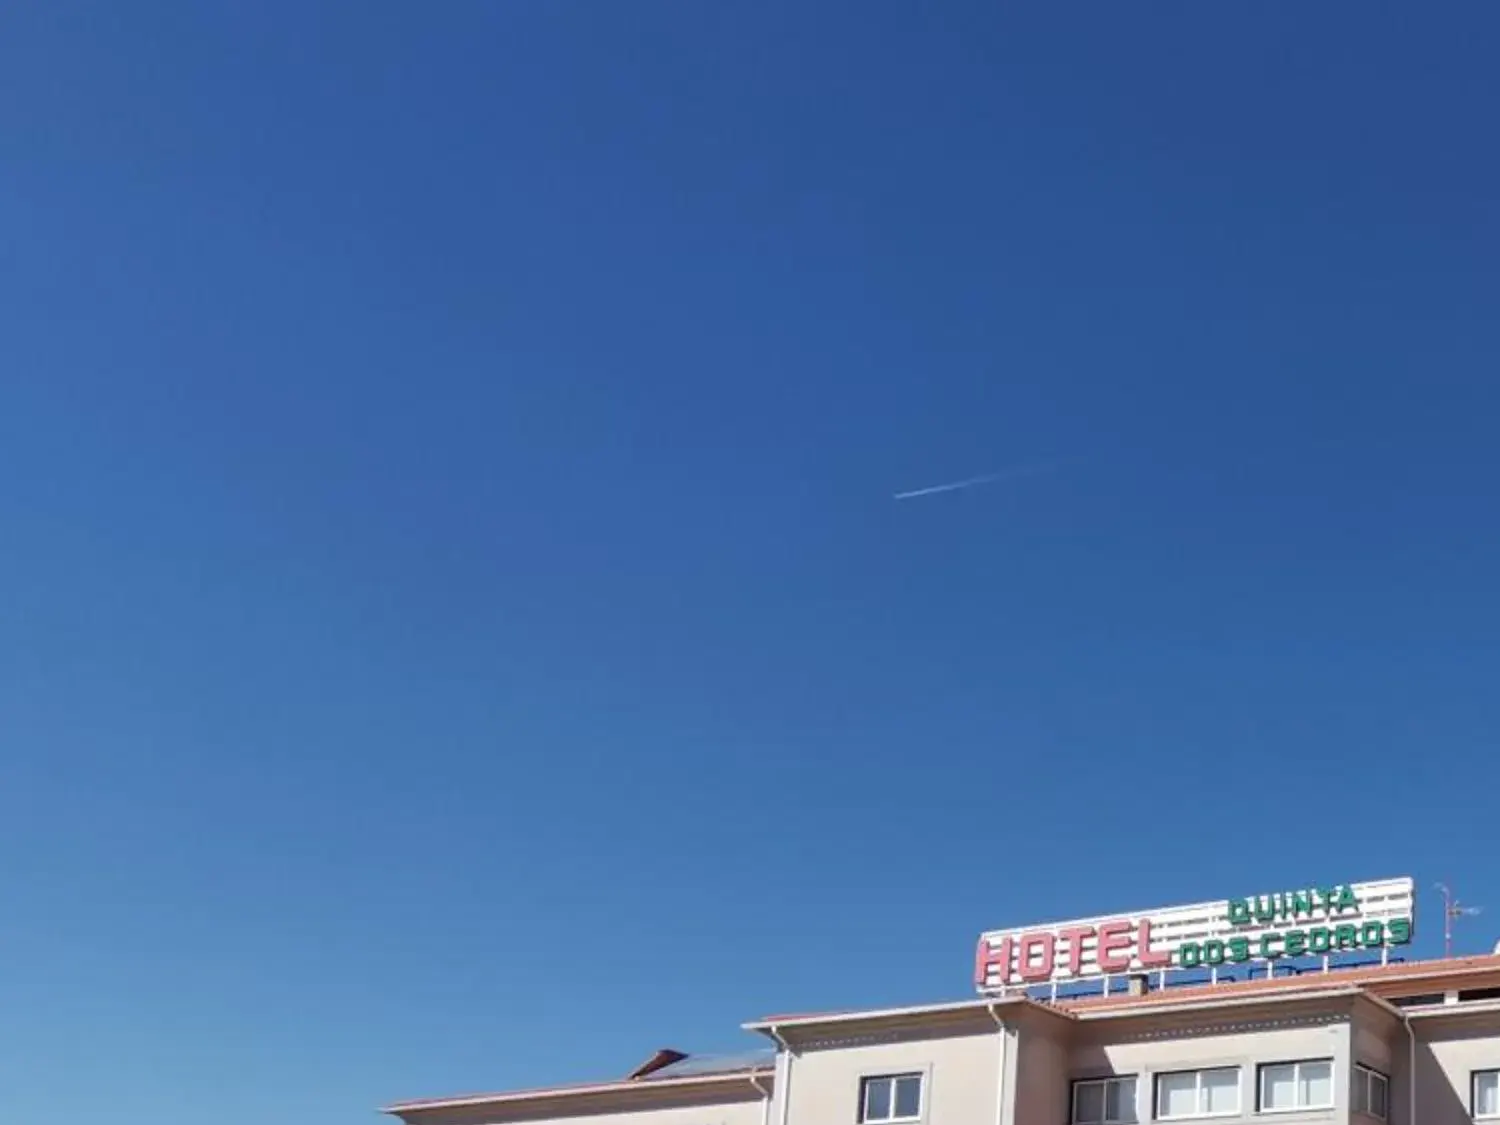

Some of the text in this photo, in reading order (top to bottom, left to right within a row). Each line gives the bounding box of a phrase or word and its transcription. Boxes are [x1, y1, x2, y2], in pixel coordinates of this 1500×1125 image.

[1228, 884, 1358, 924] QUINTA
[976, 917, 1172, 985] HOTEL
[1179, 917, 1411, 968] DOS CEDROS
